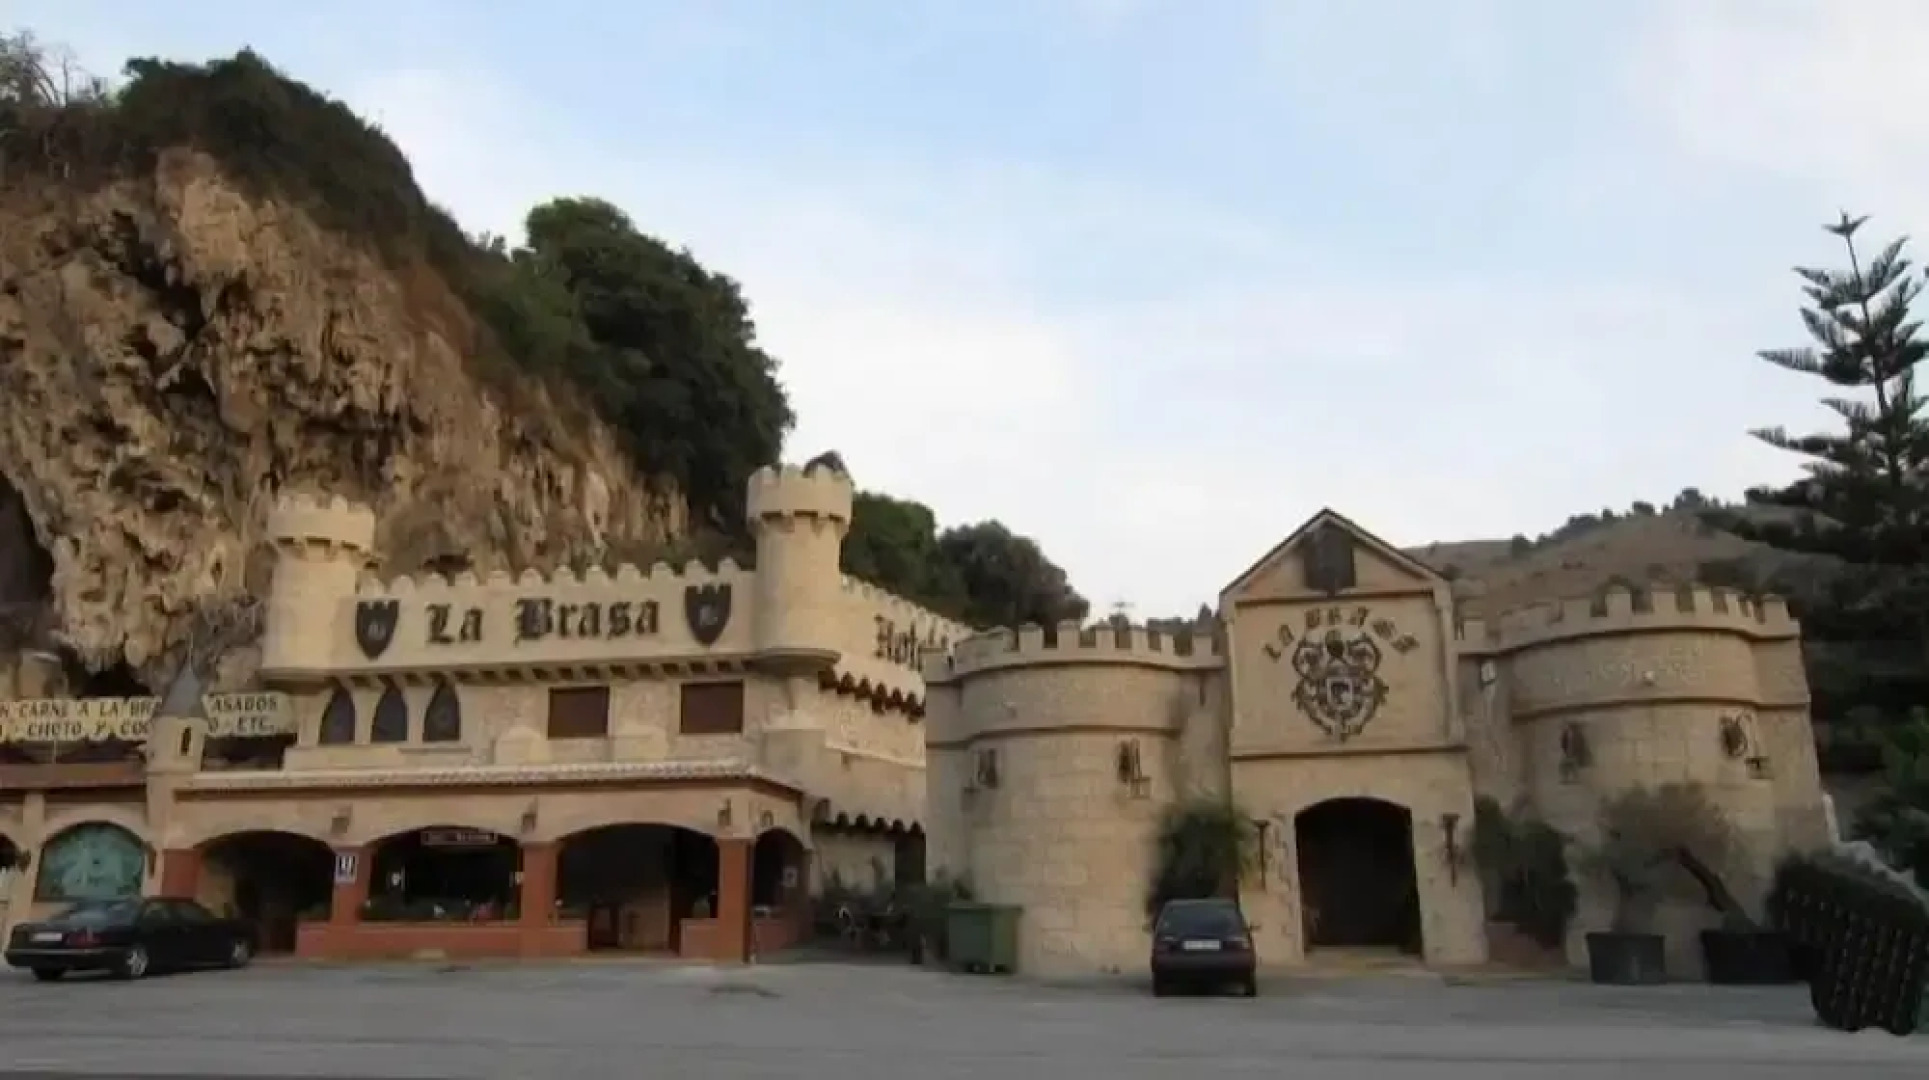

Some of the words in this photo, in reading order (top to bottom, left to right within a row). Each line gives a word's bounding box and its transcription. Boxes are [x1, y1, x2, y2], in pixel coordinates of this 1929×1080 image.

[425, 603, 483, 645] La
[513, 597, 660, 648] Brasa
[100, 701, 119, 718] LA
